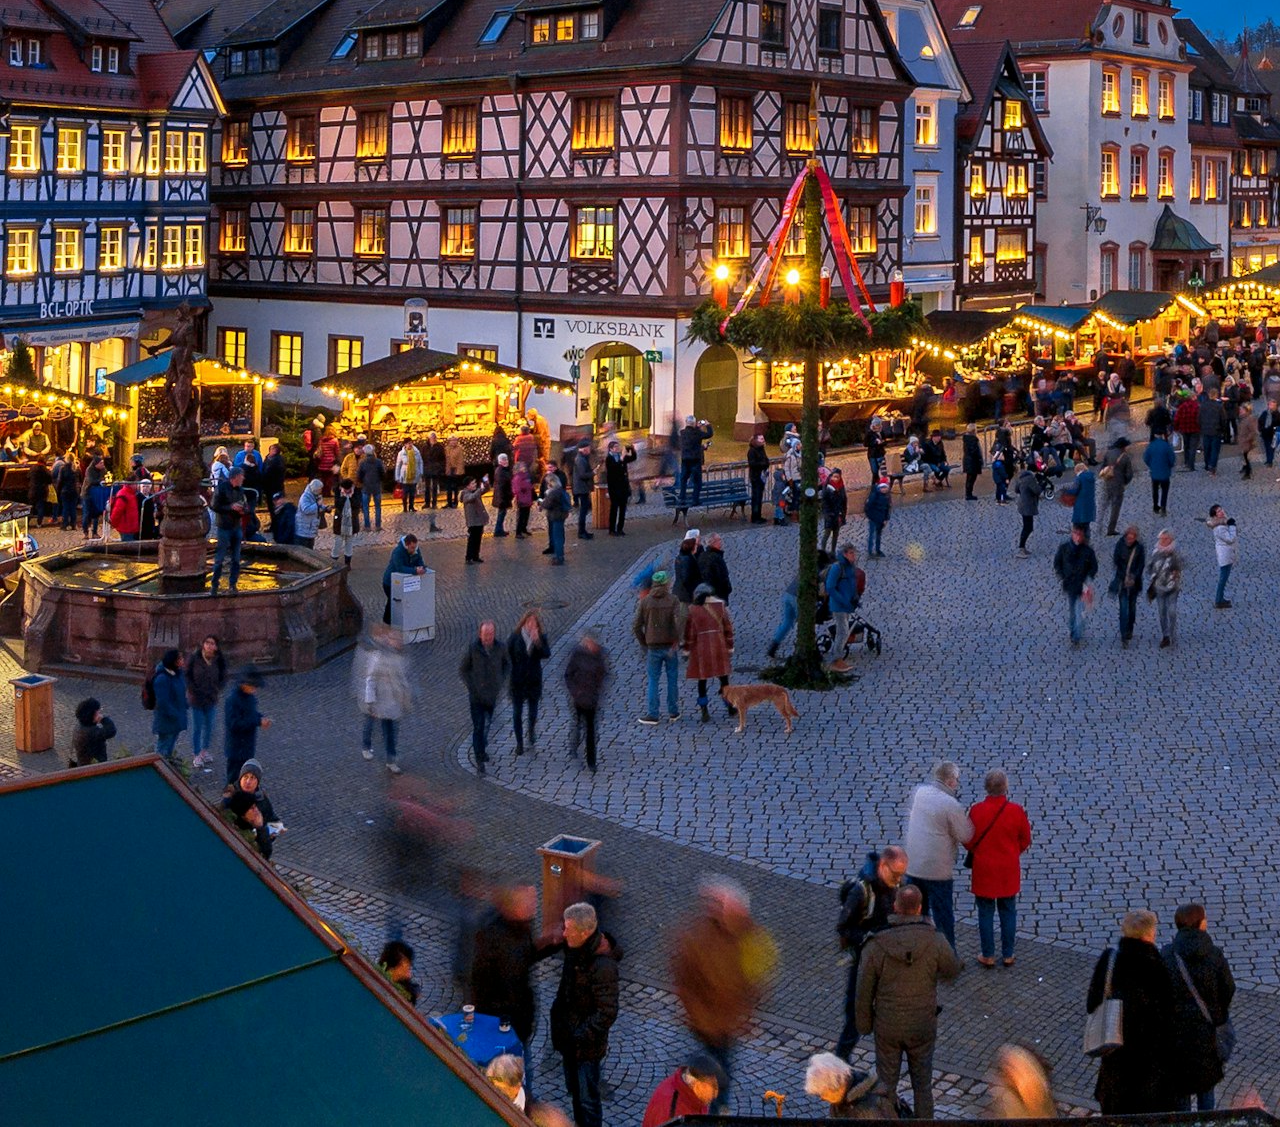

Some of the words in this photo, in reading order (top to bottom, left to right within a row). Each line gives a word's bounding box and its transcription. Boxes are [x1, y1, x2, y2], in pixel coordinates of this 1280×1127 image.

[40, 300, 95, 319] BCL-OPTIC
[564, 319, 666, 338] VOLKSBANK
[567, 348, 585, 361] WC
